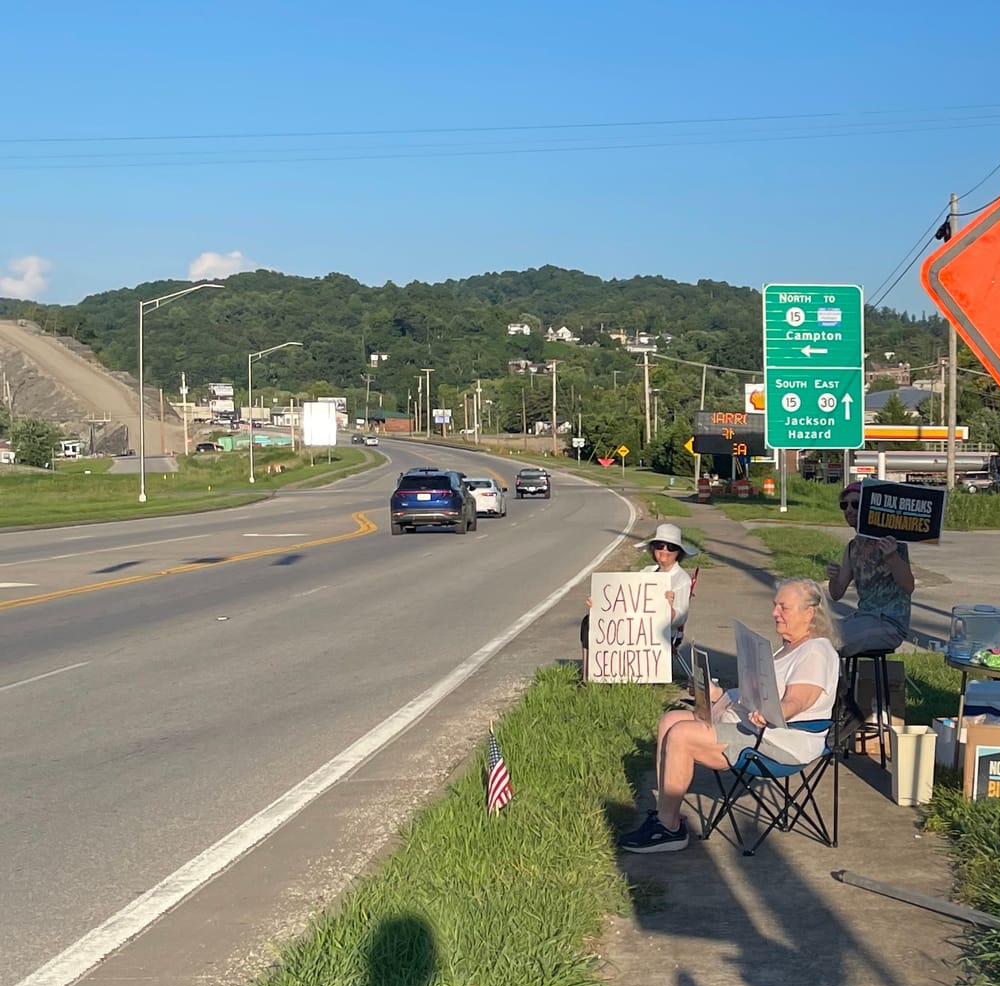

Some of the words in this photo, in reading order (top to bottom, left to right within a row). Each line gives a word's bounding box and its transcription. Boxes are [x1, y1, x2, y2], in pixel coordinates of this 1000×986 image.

[790, 311, 801, 322] 15
[786, 331, 842, 342] Campton
[775, 379, 807, 389] SOUTH
[814, 379, 840, 389] EAST
[786, 397, 797, 408] 15
[820, 397, 835, 408] 30
[785, 416, 835, 426] Jackson
[788, 430, 831, 439] Hazard
[870, 492, 881, 506] NO
[884, 494, 898, 510] TAX
[899, 498, 933, 514] BREAKS
[868, 510, 931, 533] BILLIONAIRES
[601, 583, 658, 613] SAVE
[596, 617, 661, 646] SOCIAL
[593, 649, 662, 678] SECURITY
